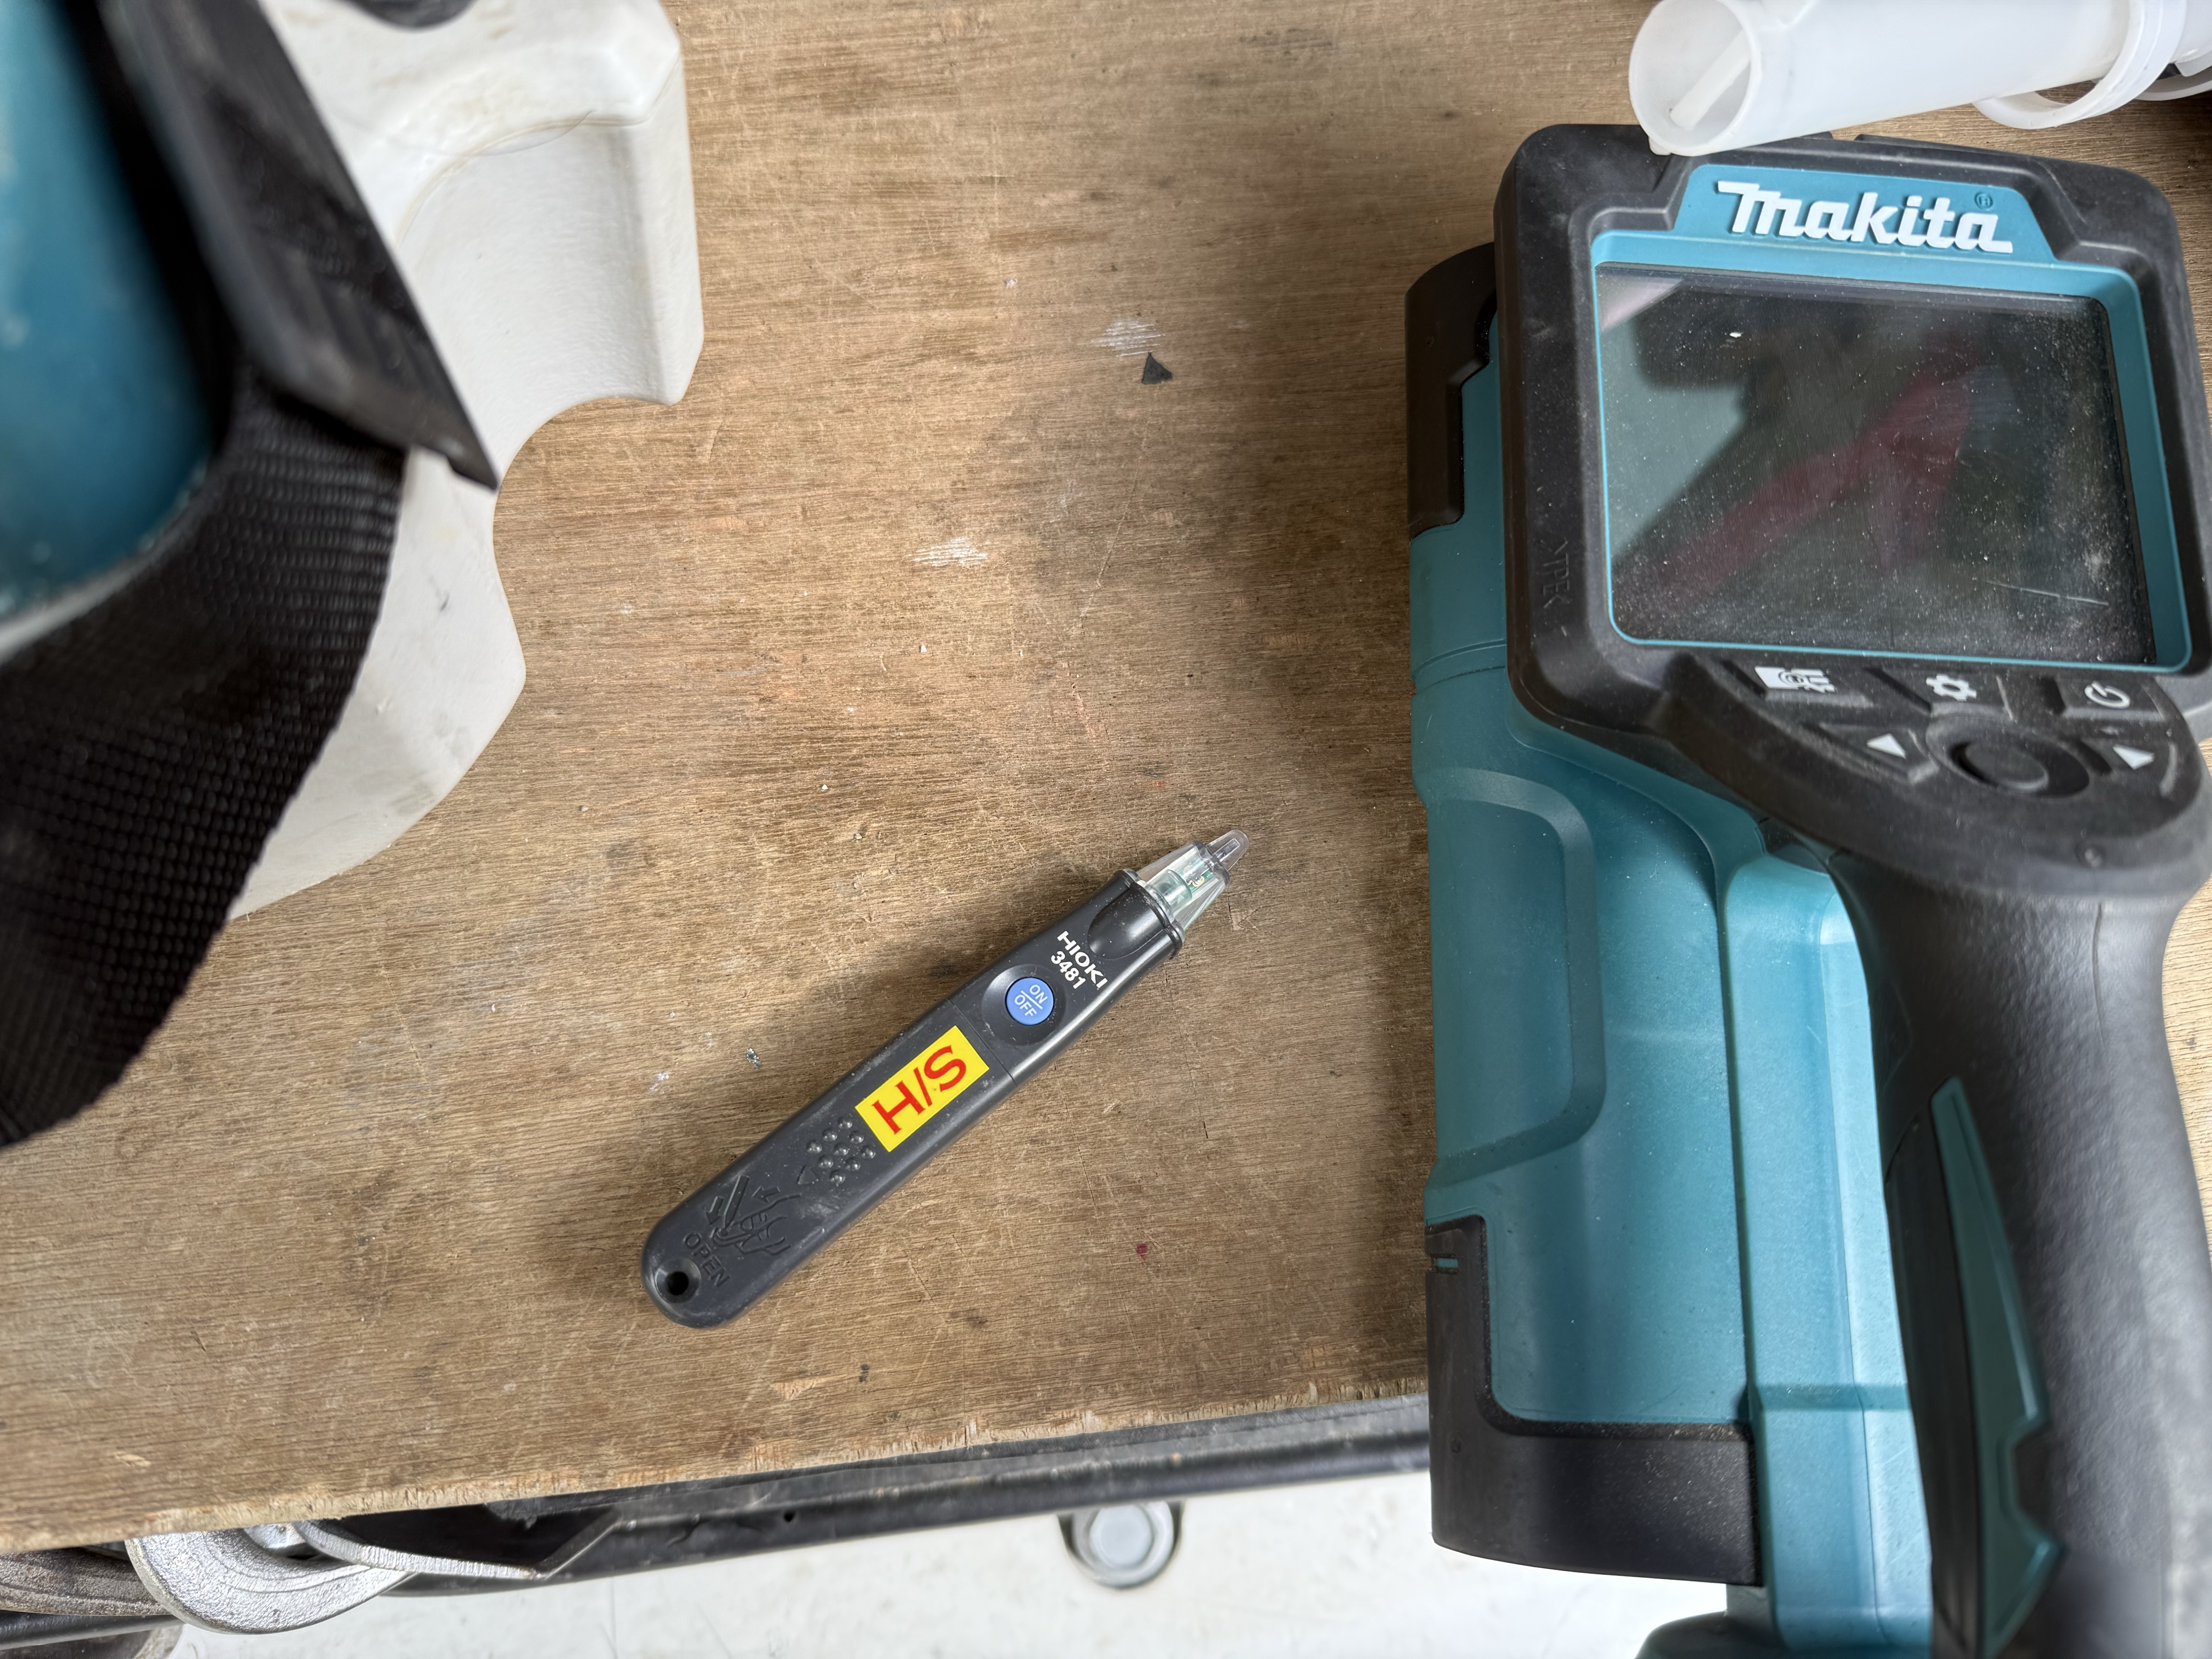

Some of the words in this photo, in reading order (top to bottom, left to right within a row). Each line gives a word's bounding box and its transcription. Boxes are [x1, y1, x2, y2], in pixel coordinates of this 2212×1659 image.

[1051, 950, 1086, 989] 3481
[1057, 930, 1108, 988] HIOKI
[1014, 995, 1037, 1017] OFF
[1029, 984, 1048, 1004] ON
[871, 1045, 967, 1135] H/S
[682, 1232, 730, 1287] OPEN
